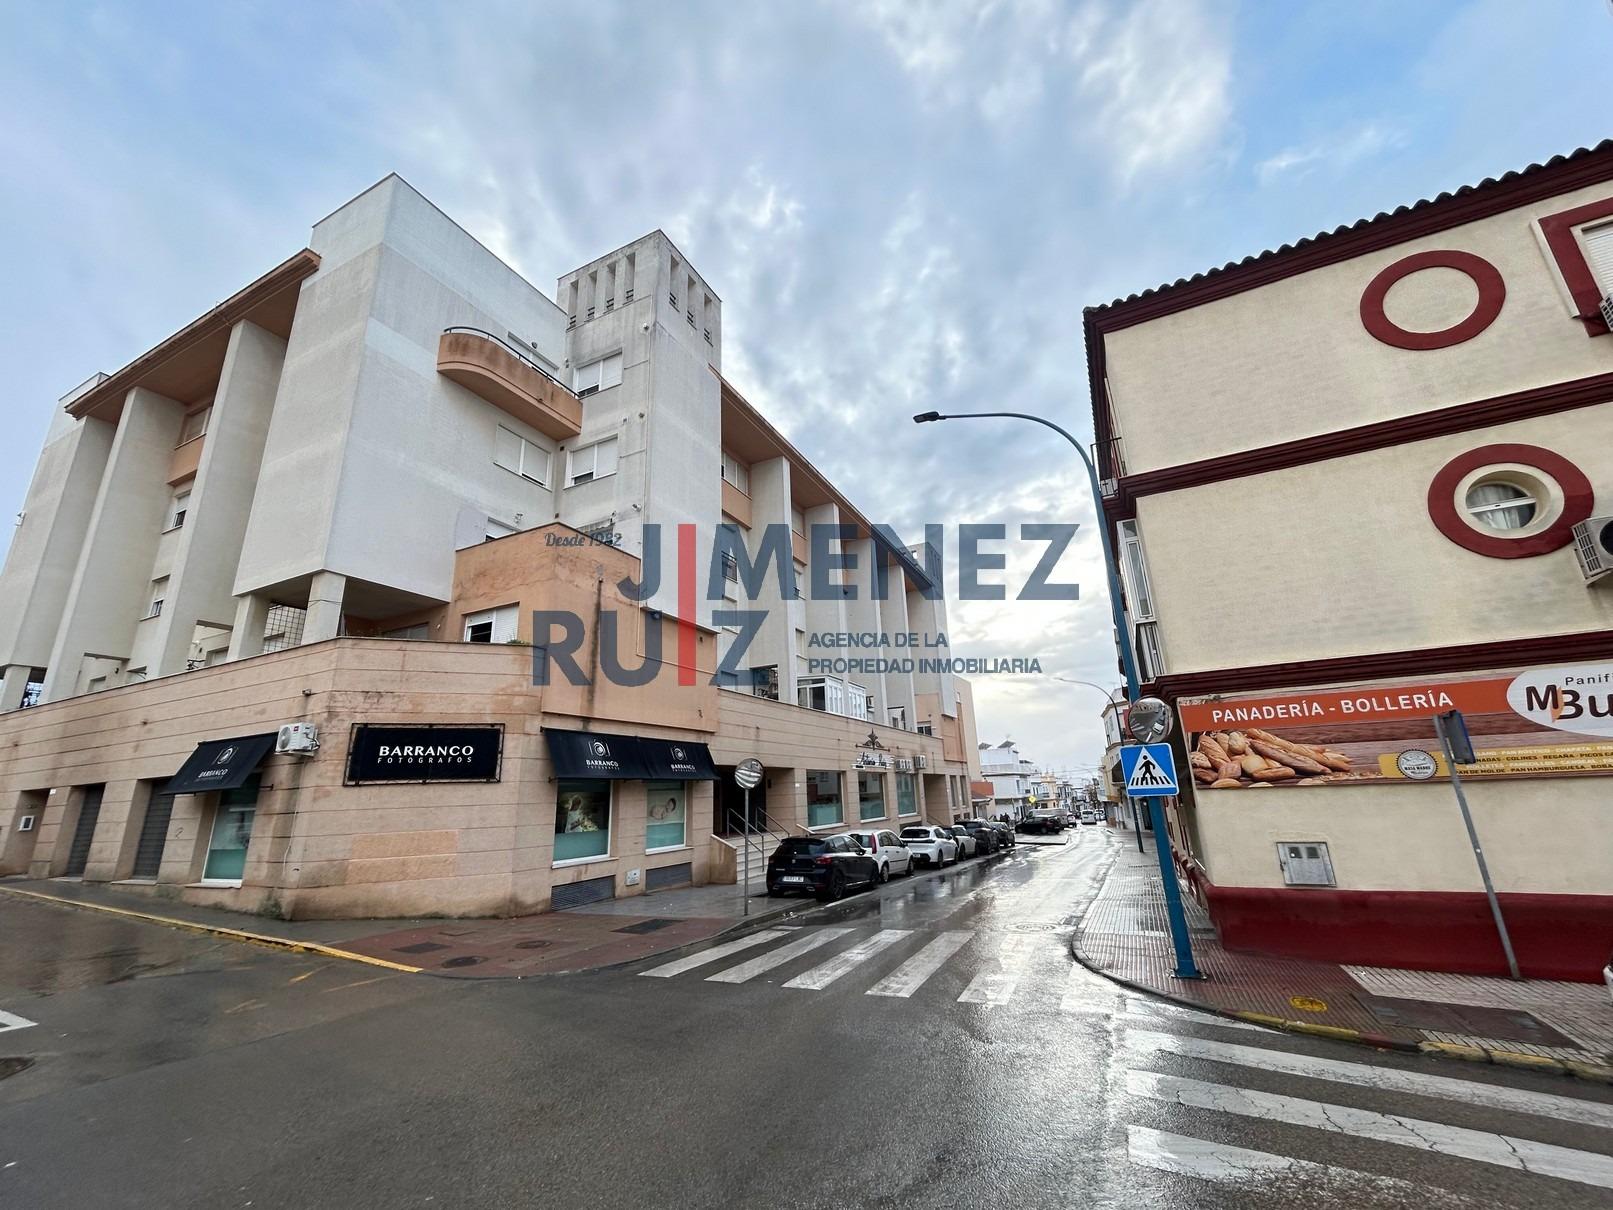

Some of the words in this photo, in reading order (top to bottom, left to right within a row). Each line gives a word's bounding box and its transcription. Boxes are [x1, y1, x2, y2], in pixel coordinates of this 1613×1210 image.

[1565, 673, 1613, 686] Panif
[1212, 700, 1325, 724] PANADERÍA
[1340, 690, 1454, 714] BOLLERÍA
[379, 745, 474, 757] BARRANCO
[586, 759, 619, 767] BARRANCO
